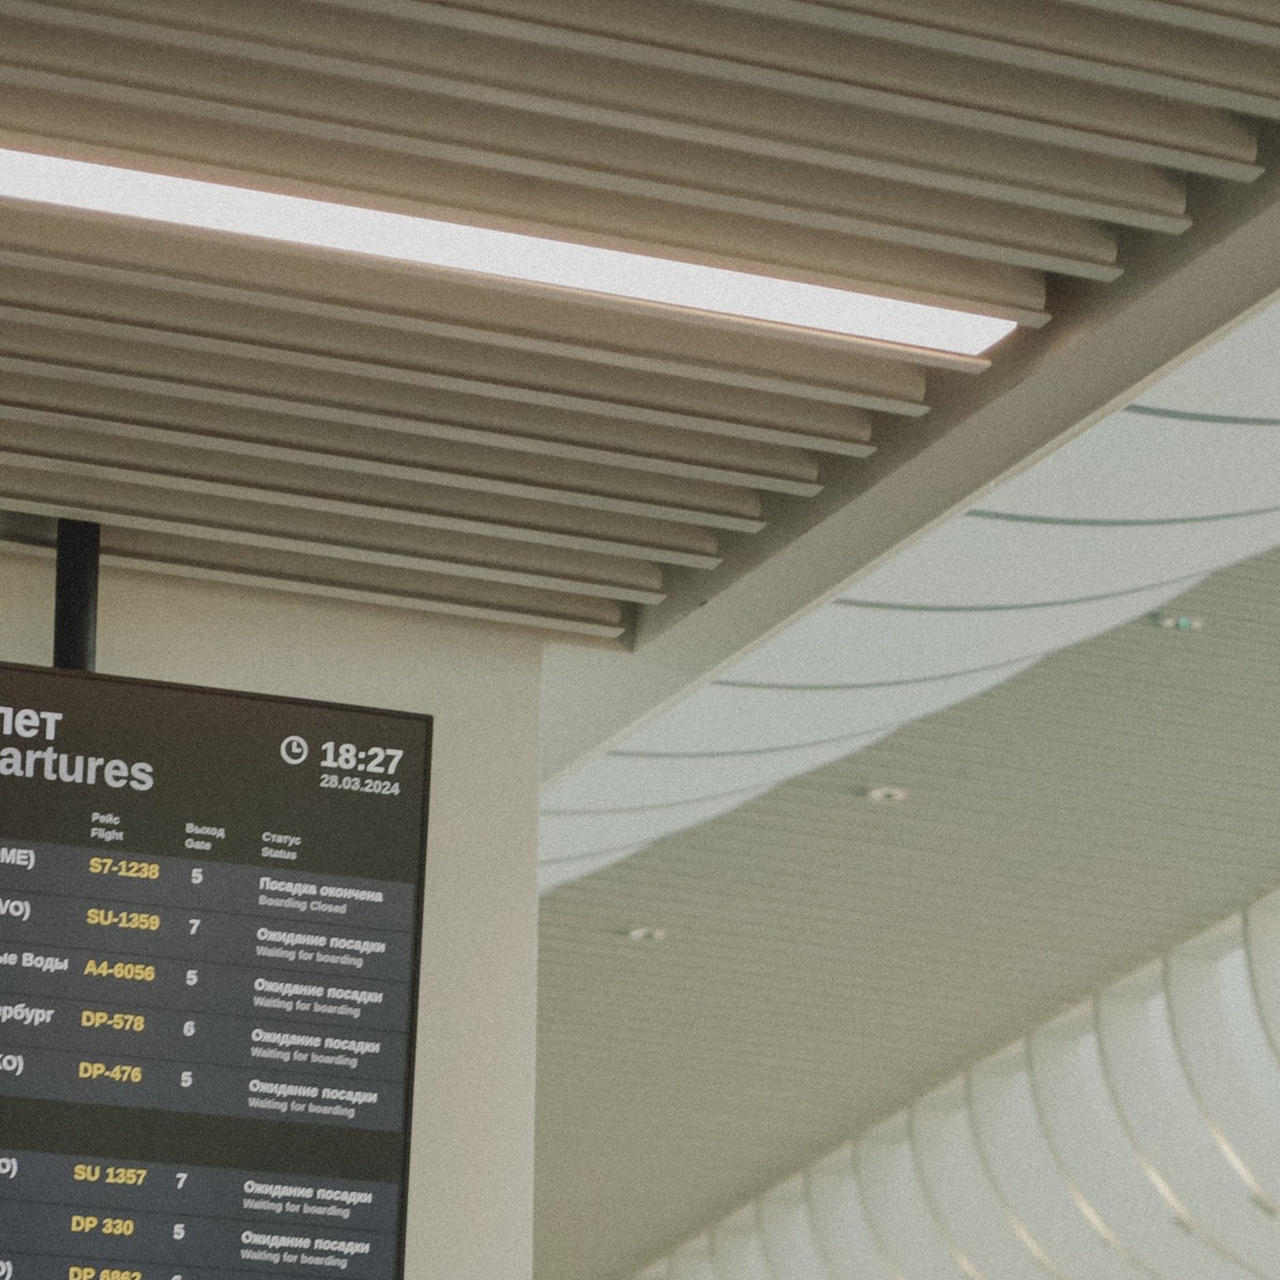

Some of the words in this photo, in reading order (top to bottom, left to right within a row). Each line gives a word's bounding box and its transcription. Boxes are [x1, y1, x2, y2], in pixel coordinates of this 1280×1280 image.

[320, 741, 403, 774] 18:27
[0, 747, 154, 791] artures
[320, 774, 400, 795] 28.03.2024
[91, 812, 120, 825] Рейс
[91, 827, 124, 841] Flight
[185, 823, 225, 839] Выход
[262, 832, 301, 847] Статус
[185, 838, 212, 850] Gate
[261, 847, 297, 860] Status
[89, 857, 160, 879] S7-1238
[191, 868, 203, 884] 5
[259, 877, 317, 897] Посадка
[319, 884, 383, 902] окончена
[259, 895, 307, 911] Boarding
[310, 901, 347, 914] Closed
[86, 908, 160, 931] SU-1359
[189, 919, 201, 935] 7
[257, 927, 327, 947] Ожидание
[330, 937, 386, 954] посадки
[22, 952, 69, 973] Воды
[256, 946, 296, 961] Waiting
[299, 950, 314, 960] for
[317, 952, 363, 968] boarding
[84, 960, 155, 981] A4-6056
[186, 970, 198, 986] 5
[254, 978, 324, 997] Ожидание
[327, 988, 383, 1004] посадки
[0, 1003, 55, 1026] рбург
[253, 996, 293, 1011] Waiting
[296, 1000, 311, 1010] for
[314, 1002, 360, 1018] boarding
[81, 1010, 145, 1032] DP-578
[183, 1021, 195, 1036] 6
[251, 1029, 321, 1047] Ожидание
[324, 1038, 381, 1055] посадки
[251, 1047, 291, 1062] Waiting
[294, 1051, 309, 1061] for
[312, 1053, 358, 1068] boarding
[79, 1062, 142, 1083] DP-476
[181, 1071, 193, 1088] 5
[249, 1079, 319, 1098] Ожидание
[322, 1088, 378, 1105] посадки
[248, 1097, 288, 1111] Waiting
[291, 1101, 306, 1111] for
[309, 1102, 355, 1118] boarding
[74, 1164, 100, 1181] SU
[105, 1167, 147, 1185] 1357
[176, 1173, 188, 1189] 7
[243, 1180, 314, 1198] Ожидание
[316, 1189, 373, 1205] посадки
[243, 1199, 283, 1213] Waiting
[286, 1202, 301, 1212] for
[304, 1204, 350, 1219] boarding
[71, 1215, 98, 1232] DP
[102, 1218, 134, 1236] 330
[173, 1224, 185, 1240] 5
[241, 1231, 311, 1249] Ожидание
[314, 1239, 370, 1255] посадки
[240, 1249, 280, 1263] Waiting
[283, 1252, 298, 1262] for
[301, 1254, 347, 1269] boarding
